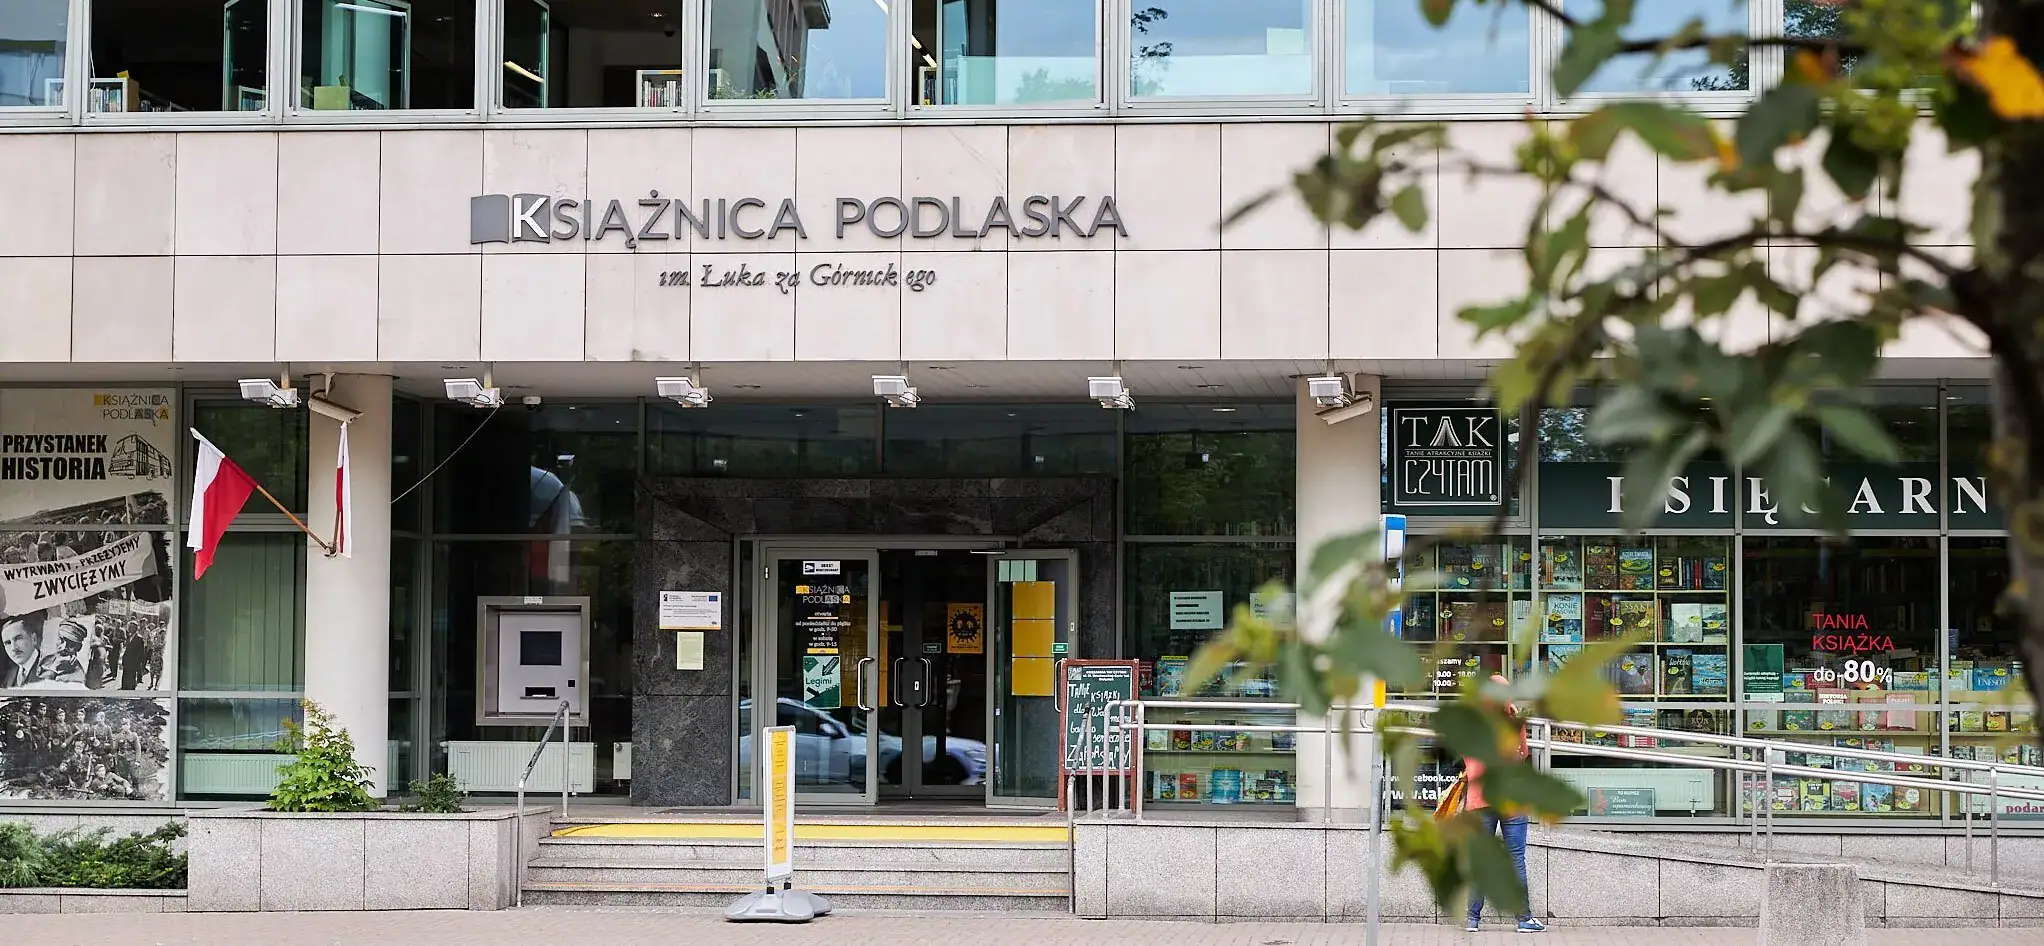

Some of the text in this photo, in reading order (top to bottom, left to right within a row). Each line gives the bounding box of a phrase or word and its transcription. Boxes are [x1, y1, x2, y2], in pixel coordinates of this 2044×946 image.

[512, 189, 1129, 249] KSIĄŻNICA PODLASKA
[905, 271, 936, 292] ego
[103, 392, 169, 407] KSIĄŻNICA
[103, 408, 169, 420] PODLASKA
[1401, 415, 1494, 447] TAK
[2, 434, 108, 454] PRZYSTANEK
[1, 457, 106, 480] HISTORIA
[1405, 459, 1492, 497] CZYTAM
[802, 595, 850, 604] PODLASKA
[1812, 613, 1869, 630] TANIA
[1812, 633, 1895, 655] KSIĄŻKA
[805, 677, 832, 687] Legimi
